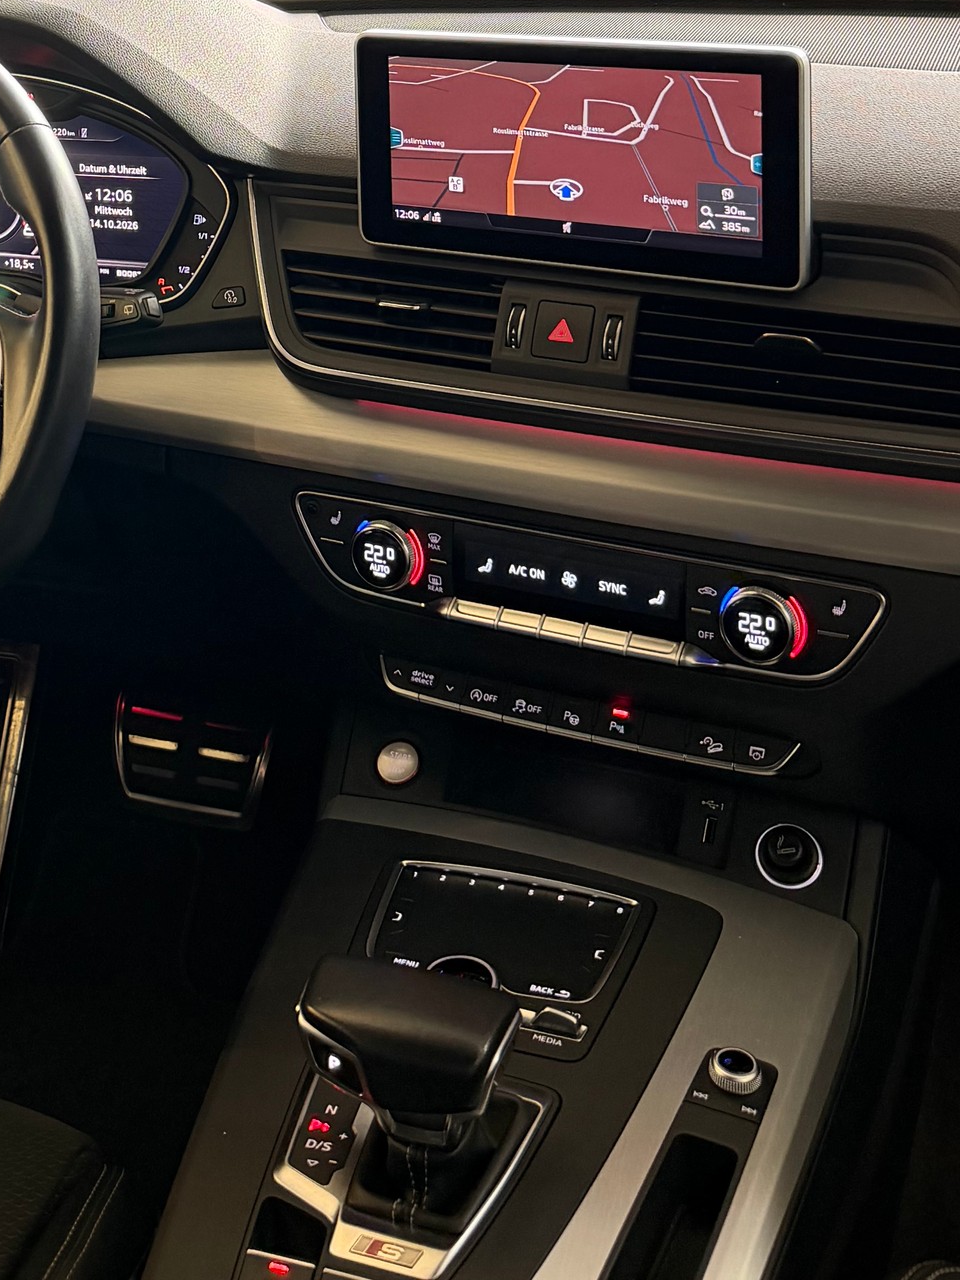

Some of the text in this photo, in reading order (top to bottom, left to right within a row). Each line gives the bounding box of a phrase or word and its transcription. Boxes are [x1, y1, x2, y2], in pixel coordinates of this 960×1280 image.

[79, 163, 148, 176] Datum & Uhrzeit
[95, 188, 133, 202] 12:06
[643, 194, 689, 209] Fabrikweg
[94, 205, 133, 217] Mittwoch
[394, 209, 420, 220] 12:06
[90, 218, 139, 230] 14.10.2026
[178, 266, 190, 274] 1/2
[427, 543, 441, 551] MAX
[369, 563, 391, 575] AUTO
[508, 564, 546, 581] A/C ON
[427, 584, 444, 593] REAR
[598, 580, 628, 596] SYNC
[697, 629, 715, 640] OFF
[744, 634, 770, 647] AUTO
[410, 675, 434, 687] select
[411, 670, 435, 681] drive
[483, 693, 499, 703] OFF
[527, 704, 543, 714] OFF
[439, 874, 447, 882] 2
[469, 878, 476, 886] 3
[393, 957, 420, 969] MENU
[529, 984, 555, 996] BACK
[532, 1033, 563, 1047] MEDIA
[325, 1104, 339, 1115] N
[304, 1138, 333, 1152] D/S
